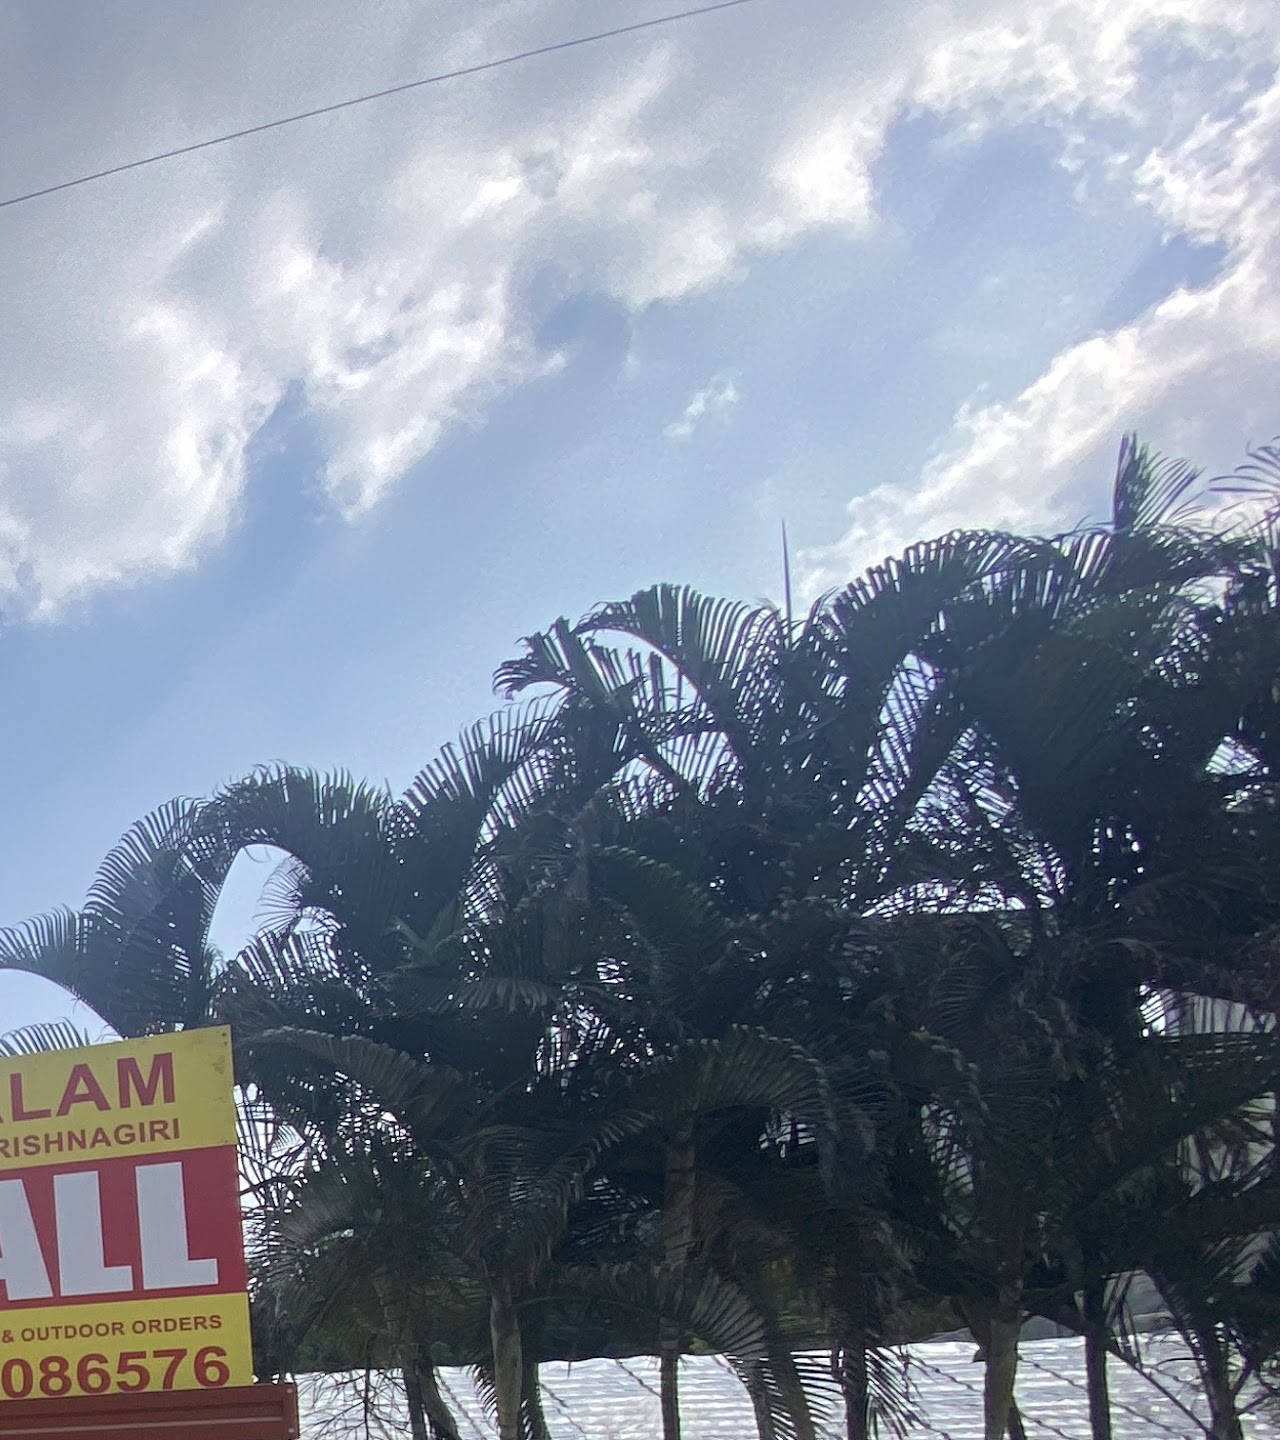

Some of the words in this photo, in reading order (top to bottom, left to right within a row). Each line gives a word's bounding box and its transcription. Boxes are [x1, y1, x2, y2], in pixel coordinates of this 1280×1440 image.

[1, 1329, 14, 1343] &
[21, 1322, 125, 1342] OUTDOOR
[132, 1315, 222, 1334] ORDERS
